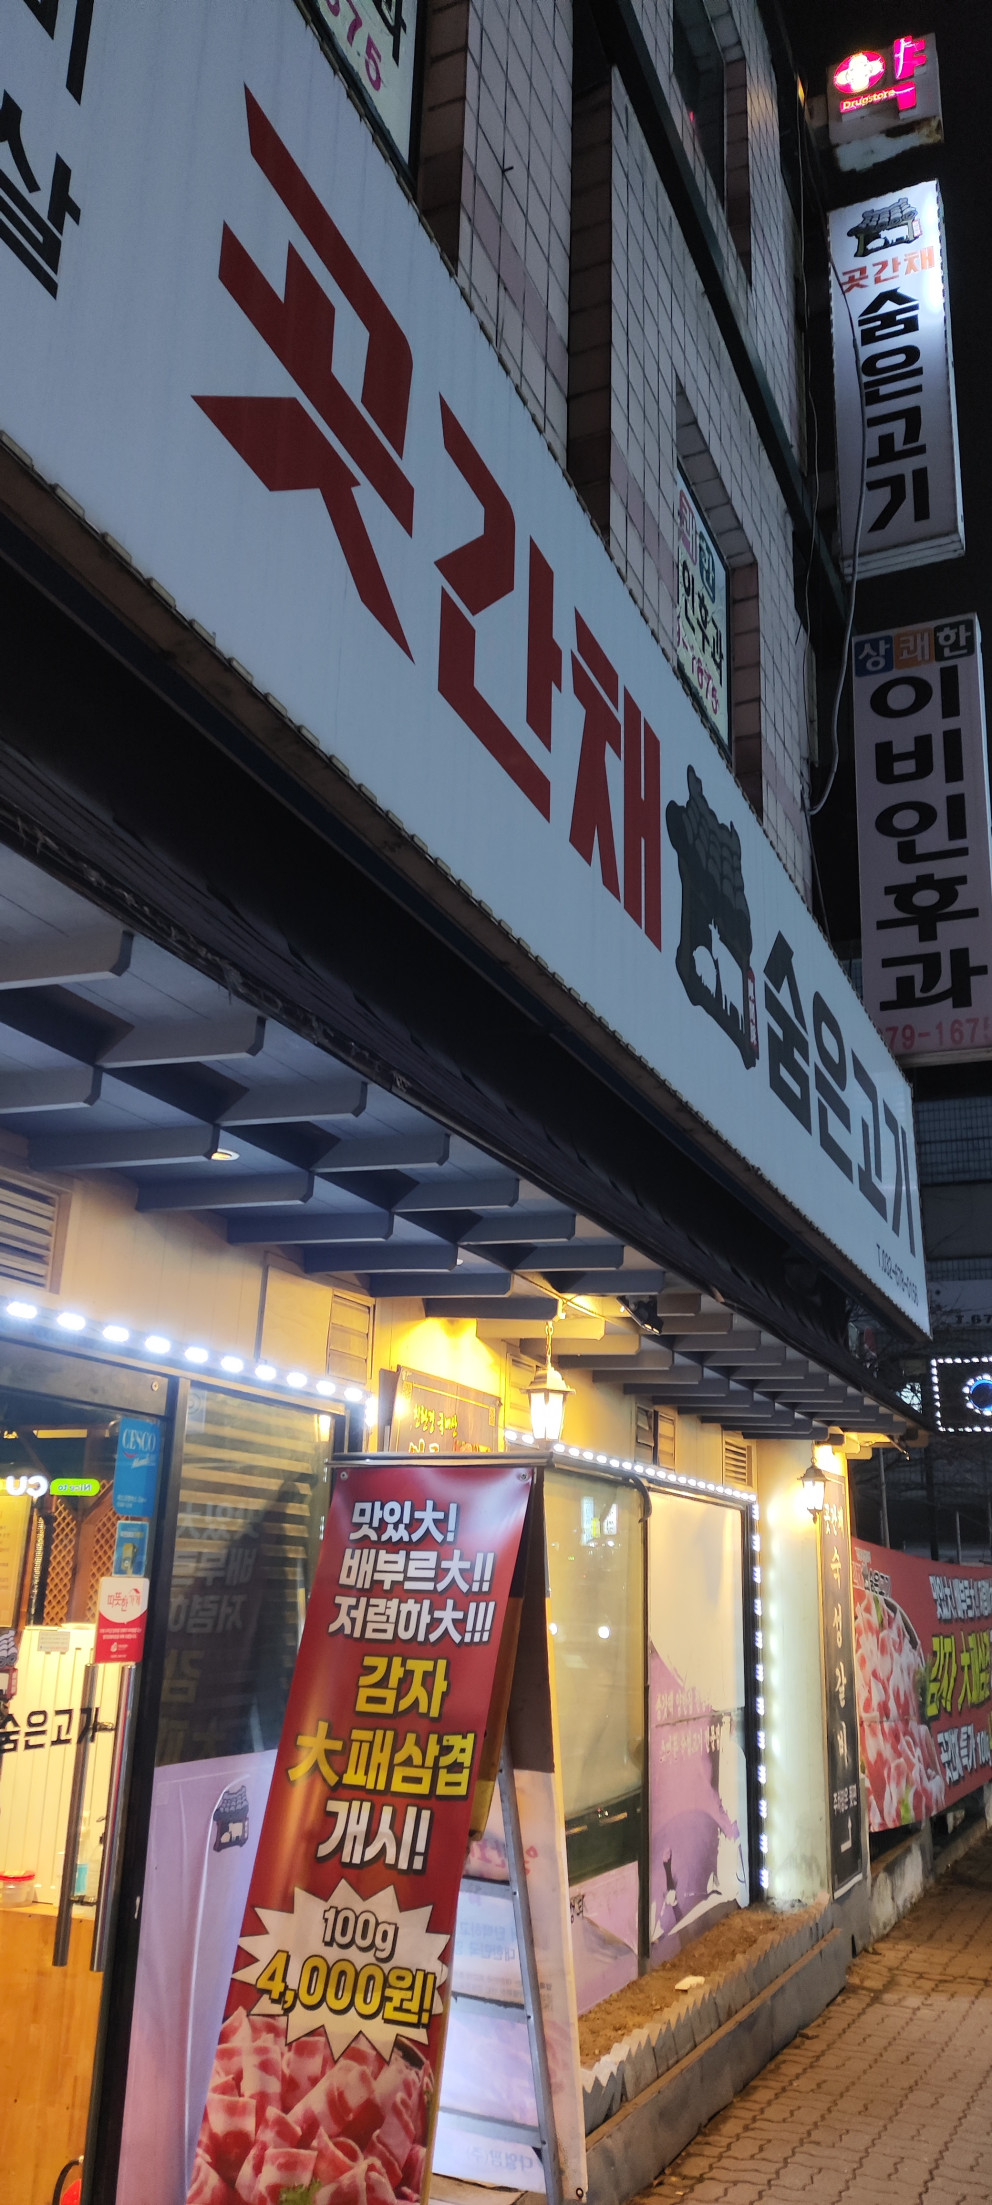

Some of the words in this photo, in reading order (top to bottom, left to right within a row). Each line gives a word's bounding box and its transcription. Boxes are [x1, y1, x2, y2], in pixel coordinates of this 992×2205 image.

[842, 88, 896, 110] Drugstore
[893, 35, 927, 111] 약
[842, 245, 935, 294] 곳간채
[857, 286, 931, 534] 숨은고기
[191, 82, 661, 952] 곳간채
[857, 624, 972, 672] 상쾌한
[869, 664, 988, 1012] 이비인후과
[763, 929, 917, 1259] 숨은고기
[122, 1428, 157, 1451] CESCO
[355, 1655, 450, 1718] 감자
[927, 1635, 957, 1717] 감자
[316, 1800, 432, 1870] 개시!
[322, 1906, 398, 1959] 100g
[255, 1950, 437, 2024] 4,000원!
